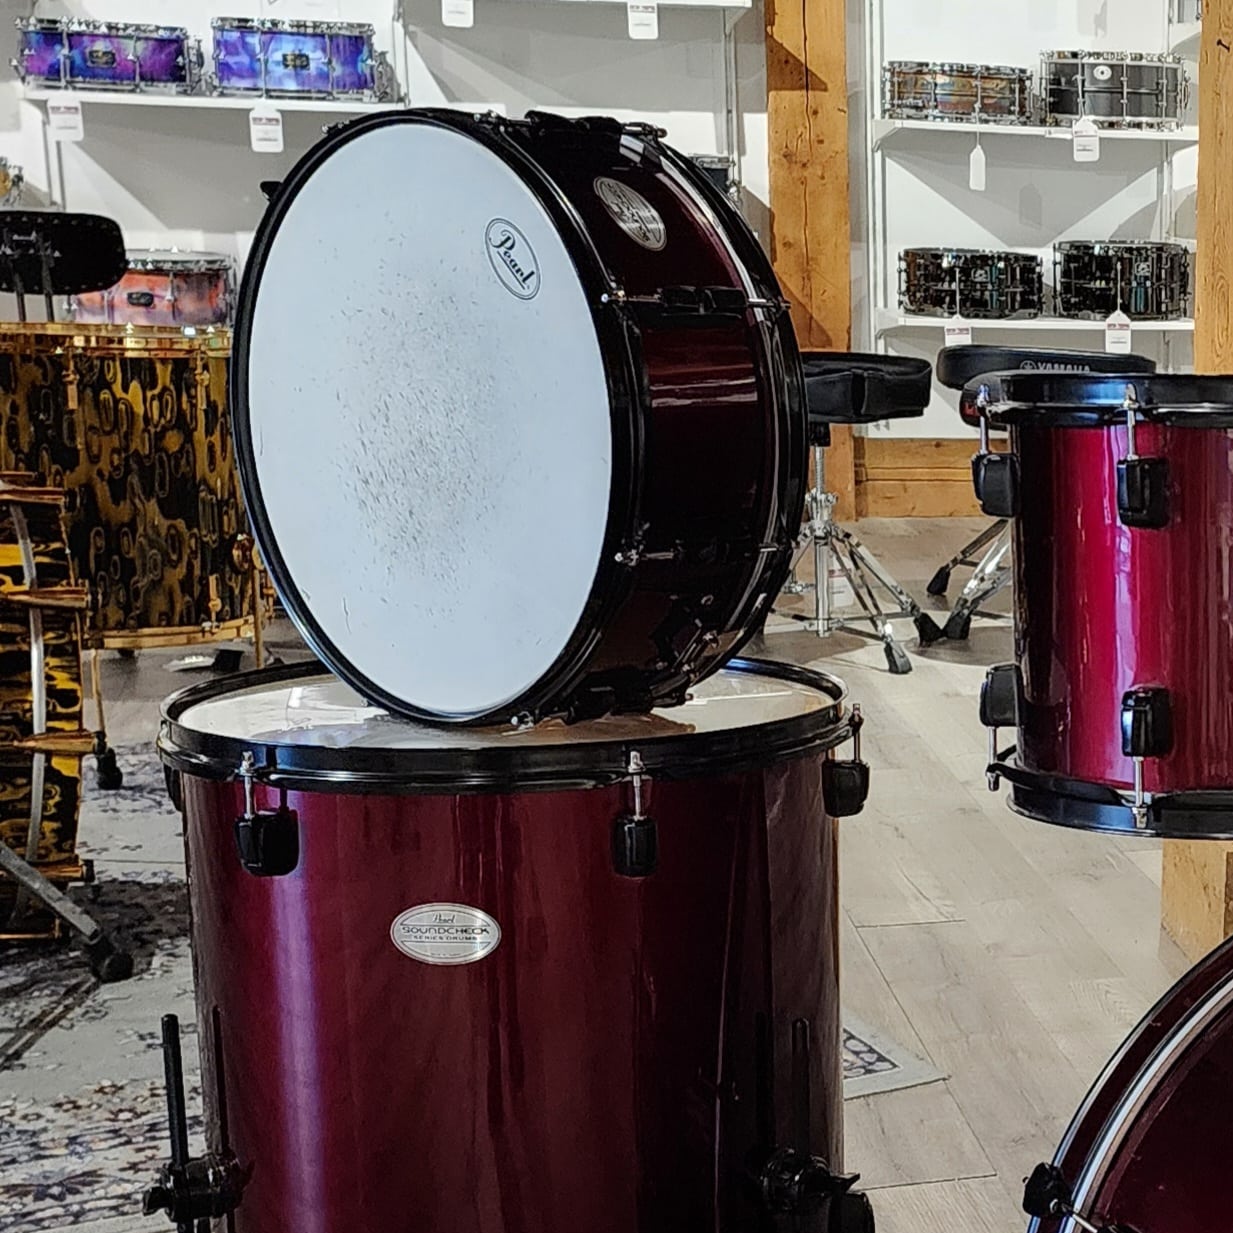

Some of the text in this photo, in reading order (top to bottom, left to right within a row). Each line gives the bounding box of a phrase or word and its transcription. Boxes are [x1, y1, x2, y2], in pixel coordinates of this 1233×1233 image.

[488, 229, 535, 286] Pearl
[1038, 362, 1091, 374] YAMAHA
[402, 926, 489, 936] SOUNDCHECK
